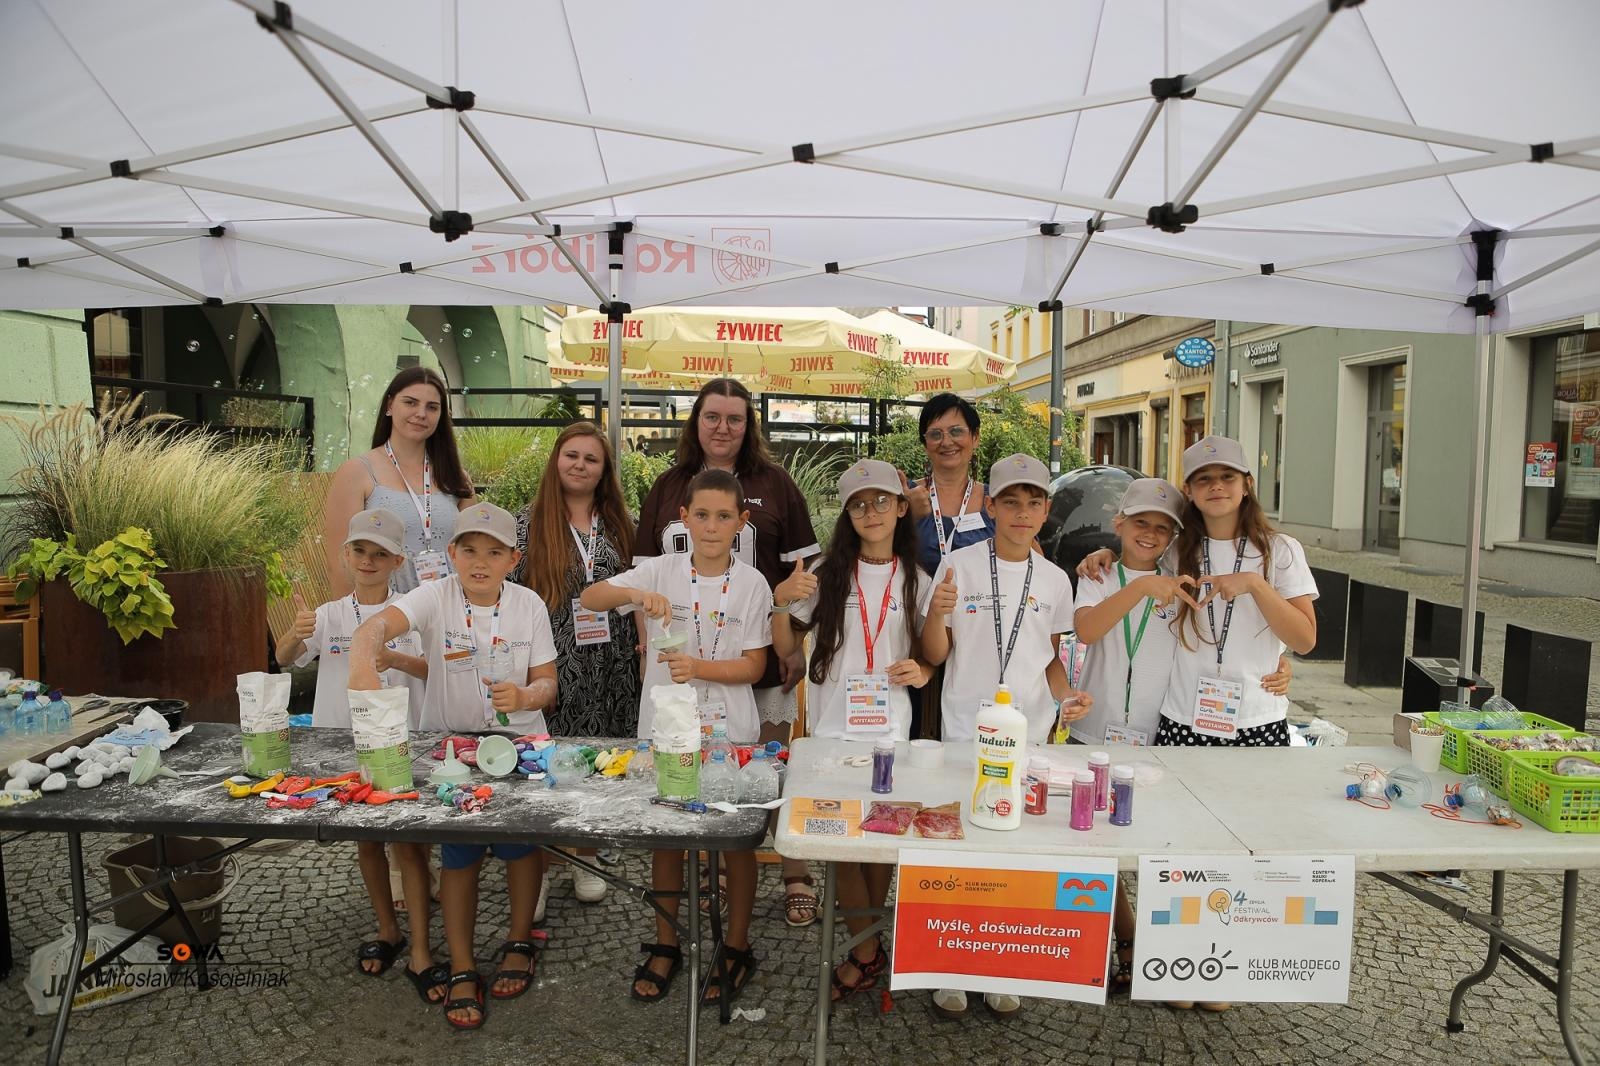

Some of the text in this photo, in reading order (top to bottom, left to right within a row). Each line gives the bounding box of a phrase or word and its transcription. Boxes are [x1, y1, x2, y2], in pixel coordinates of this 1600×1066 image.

[593, 319, 643, 339] ŻYIEC
[716, 320, 784, 342] ŻYWIEC
[847, 331, 878, 354] ŻYWIEC
[1251, 341, 1279, 356] Santander
[903, 350, 950, 366] ŻYWIEC
[986, 358, 1005, 375] ŻYWIEC
[1199, 720, 1230, 730] WYSTAWCA
[978, 734, 1016, 748] ludwik
[1159, 870, 1208, 882] SOWA
[1233, 889, 1248, 906] 4
[927, 918, 1081, 938] Myślę, doświadczam
[938, 937, 1071, 958] i eksperymentuję
[1248, 958, 1341, 970] KLUB MŁODEGO
[1247, 970, 1315, 981] ODKRYWCY
